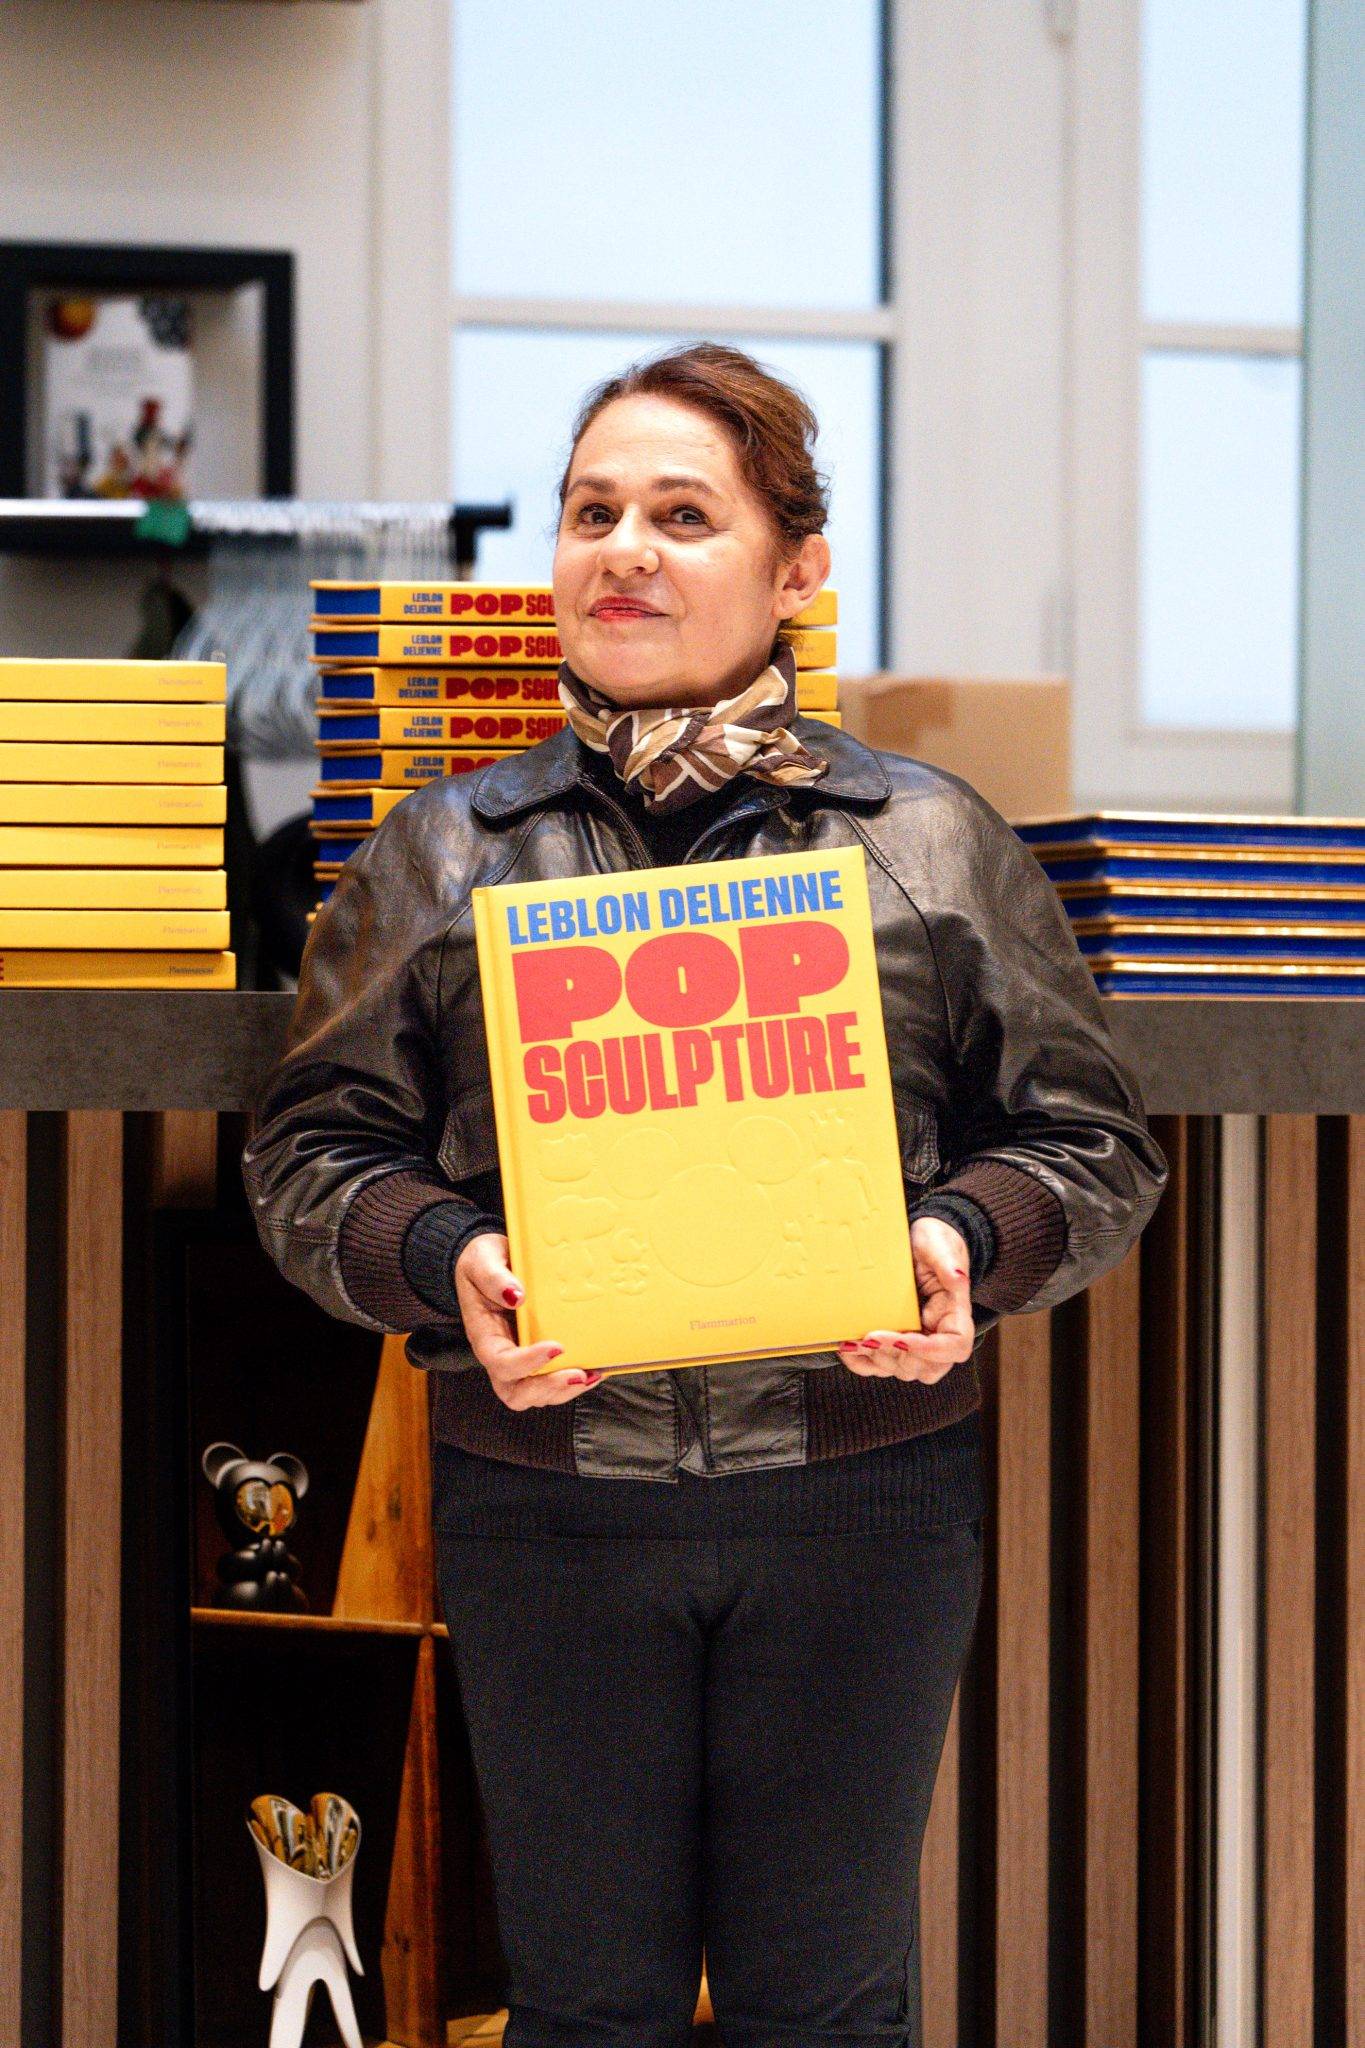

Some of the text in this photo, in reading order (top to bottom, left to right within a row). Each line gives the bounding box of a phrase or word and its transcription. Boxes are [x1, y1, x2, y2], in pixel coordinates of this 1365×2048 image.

[412, 592, 443, 602] LEBLON
[450, 593, 523, 615] POP
[411, 634, 442, 644] LEBLON
[450, 635, 522, 657] POP
[407, 677, 439, 686] LEBLON
[445, 677, 519, 700] POP
[412, 716, 443, 726] LEBLON
[450, 716, 523, 739] POP
[413, 757, 444, 766] LEBLON
[507, 870, 843, 945] LEBLON DELIENNE
[512, 920, 850, 1044] POP
[523, 1011, 866, 1124] SCULPTURE
[689, 1316, 757, 1330] Flammarion
